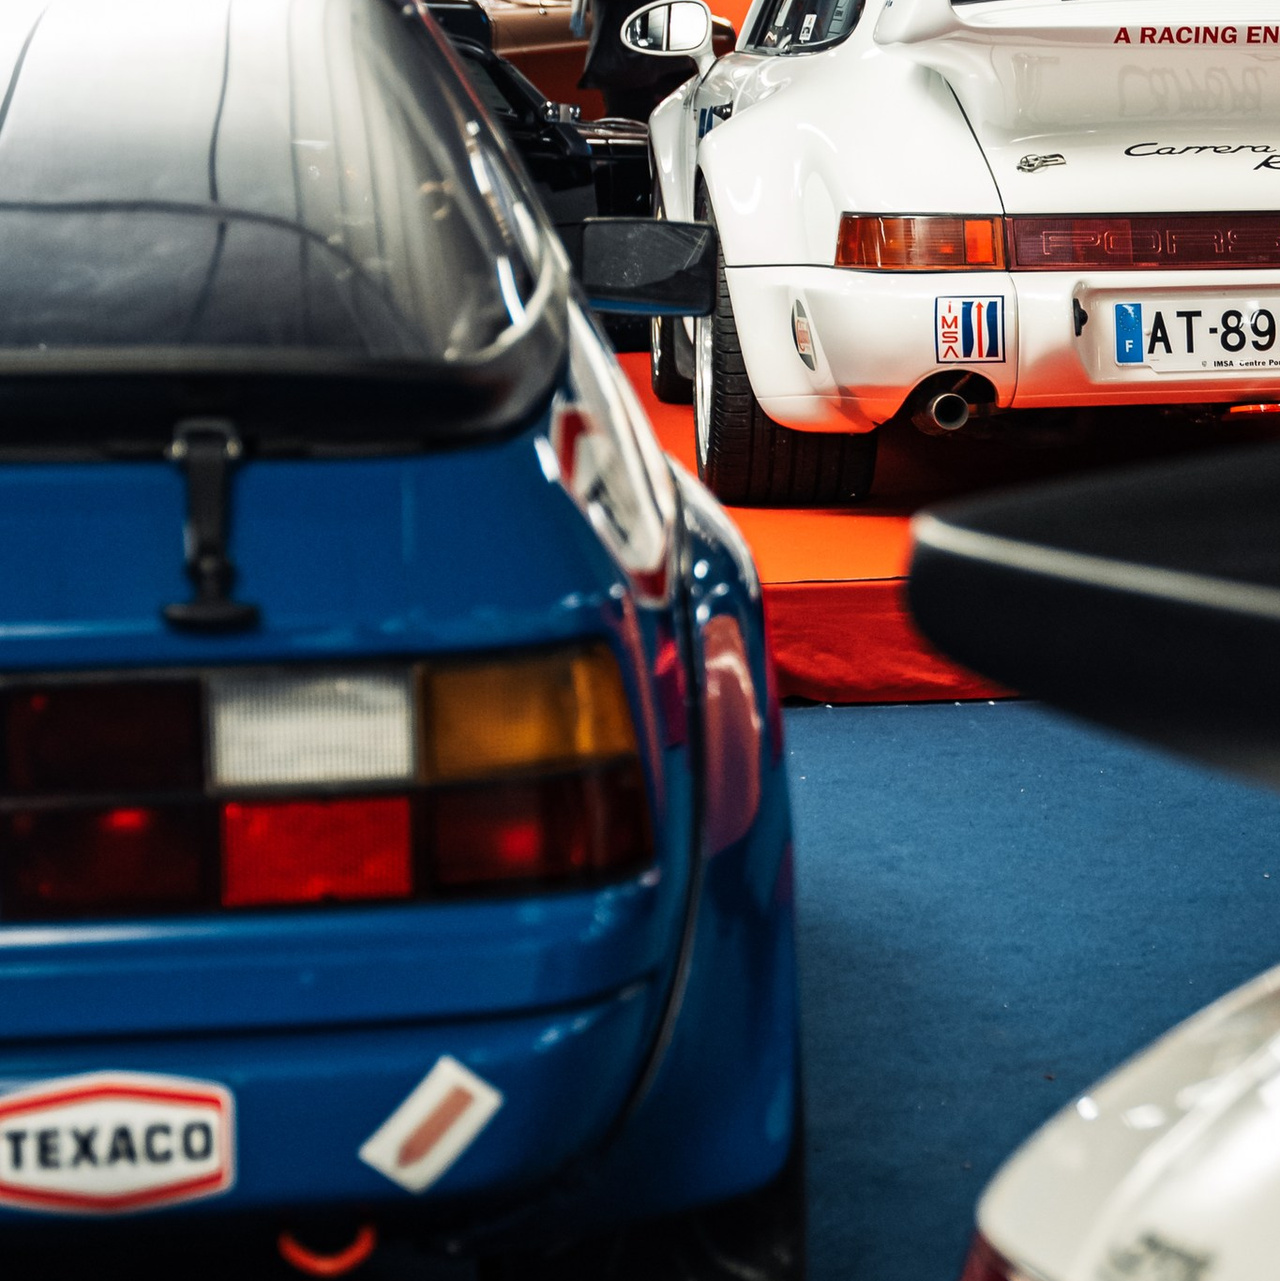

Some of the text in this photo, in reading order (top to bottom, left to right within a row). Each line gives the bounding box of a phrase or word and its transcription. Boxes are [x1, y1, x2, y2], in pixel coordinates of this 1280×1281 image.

[1114, 26, 1131, 44] A
[1140, 26, 1237, 44] RACING
[1124, 142, 1277, 157] Carrera
[1125, 340, 1134, 353] F
[6, 1122, 213, 1170] TEXACO
